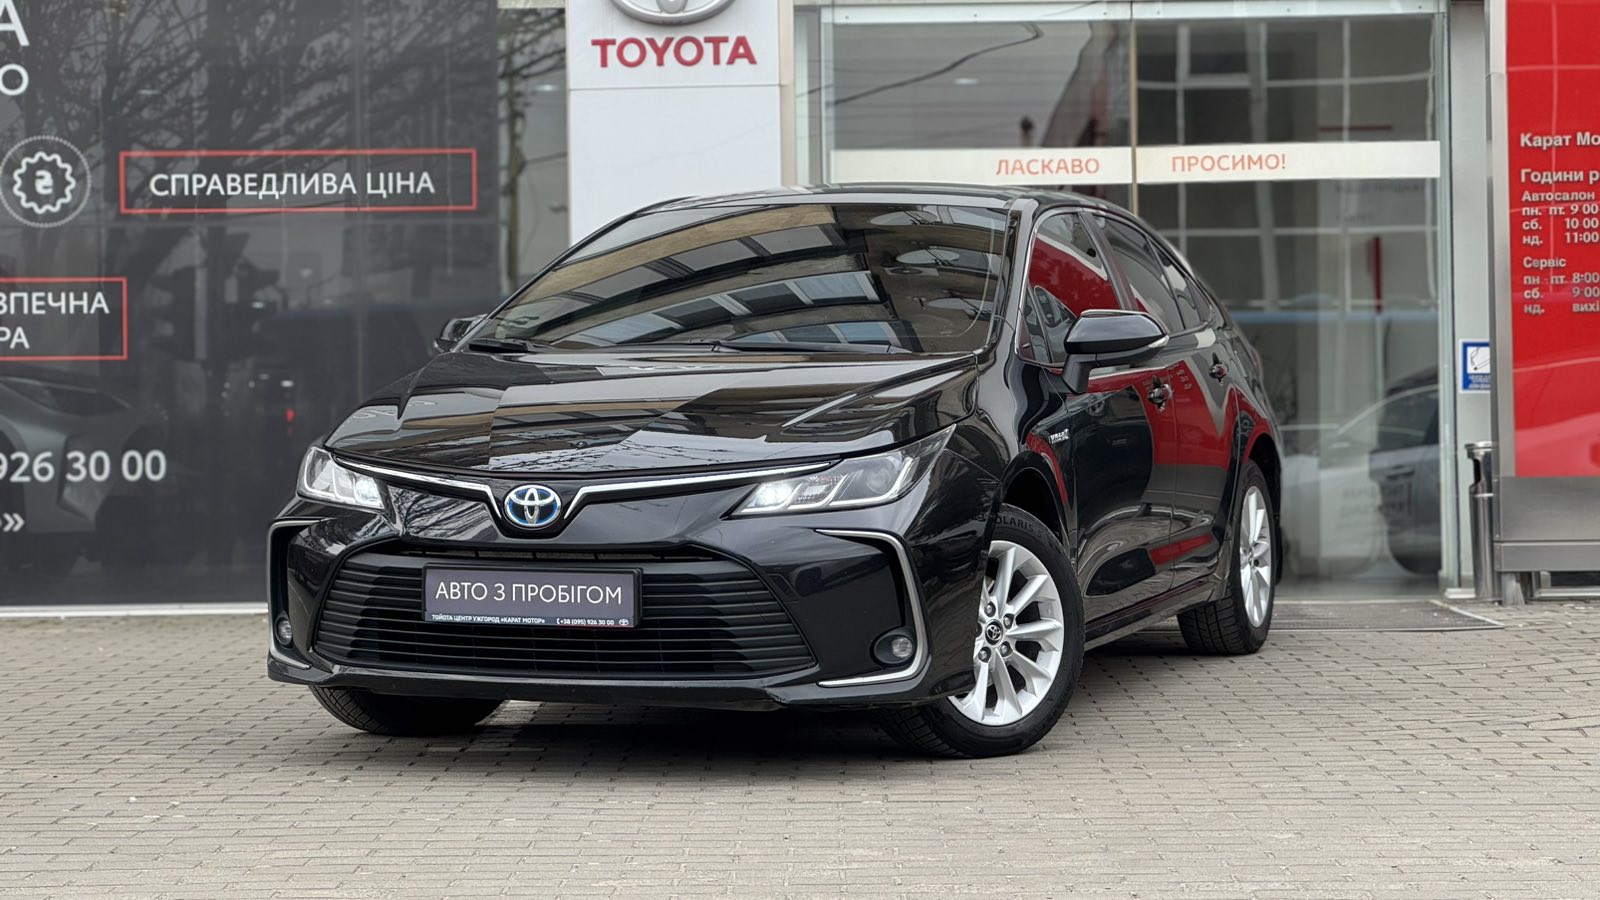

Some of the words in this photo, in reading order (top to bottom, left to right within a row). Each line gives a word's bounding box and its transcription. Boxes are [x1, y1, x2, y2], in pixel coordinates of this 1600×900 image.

[591, 36, 758, 68] TOYOTA
[1520, 132, 1572, 151] Карат
[1576, 131, 1600, 146] Мо
[996, 157, 1100, 176] ЛАСКАВО
[1171, 153, 1287, 173] ПРОСИМО!
[1520, 168, 1584, 185] Години
[150, 172, 357, 200] СПРАВЕДЛИВА
[366, 171, 436, 199] ЦІНА
[1521, 190, 1596, 202] Автосалон
[1522, 218, 1542, 230] сб.
[1522, 235, 1543, 246] нд.
[1564, 231, 1600, 244] 11:00
[1523, 256, 1567, 271] Сервіс
[1572, 272, 1600, 284] 8:00
[1524, 304, 1545, 315] нд.
[66, 451, 111, 482] 30
[121, 450, 167, 482] 00
[435, 581, 488, 601] АВТО
[512, 584, 622, 605] ПРОБІГОМ
[431, 613, 453, 621] ТОЙОТА
